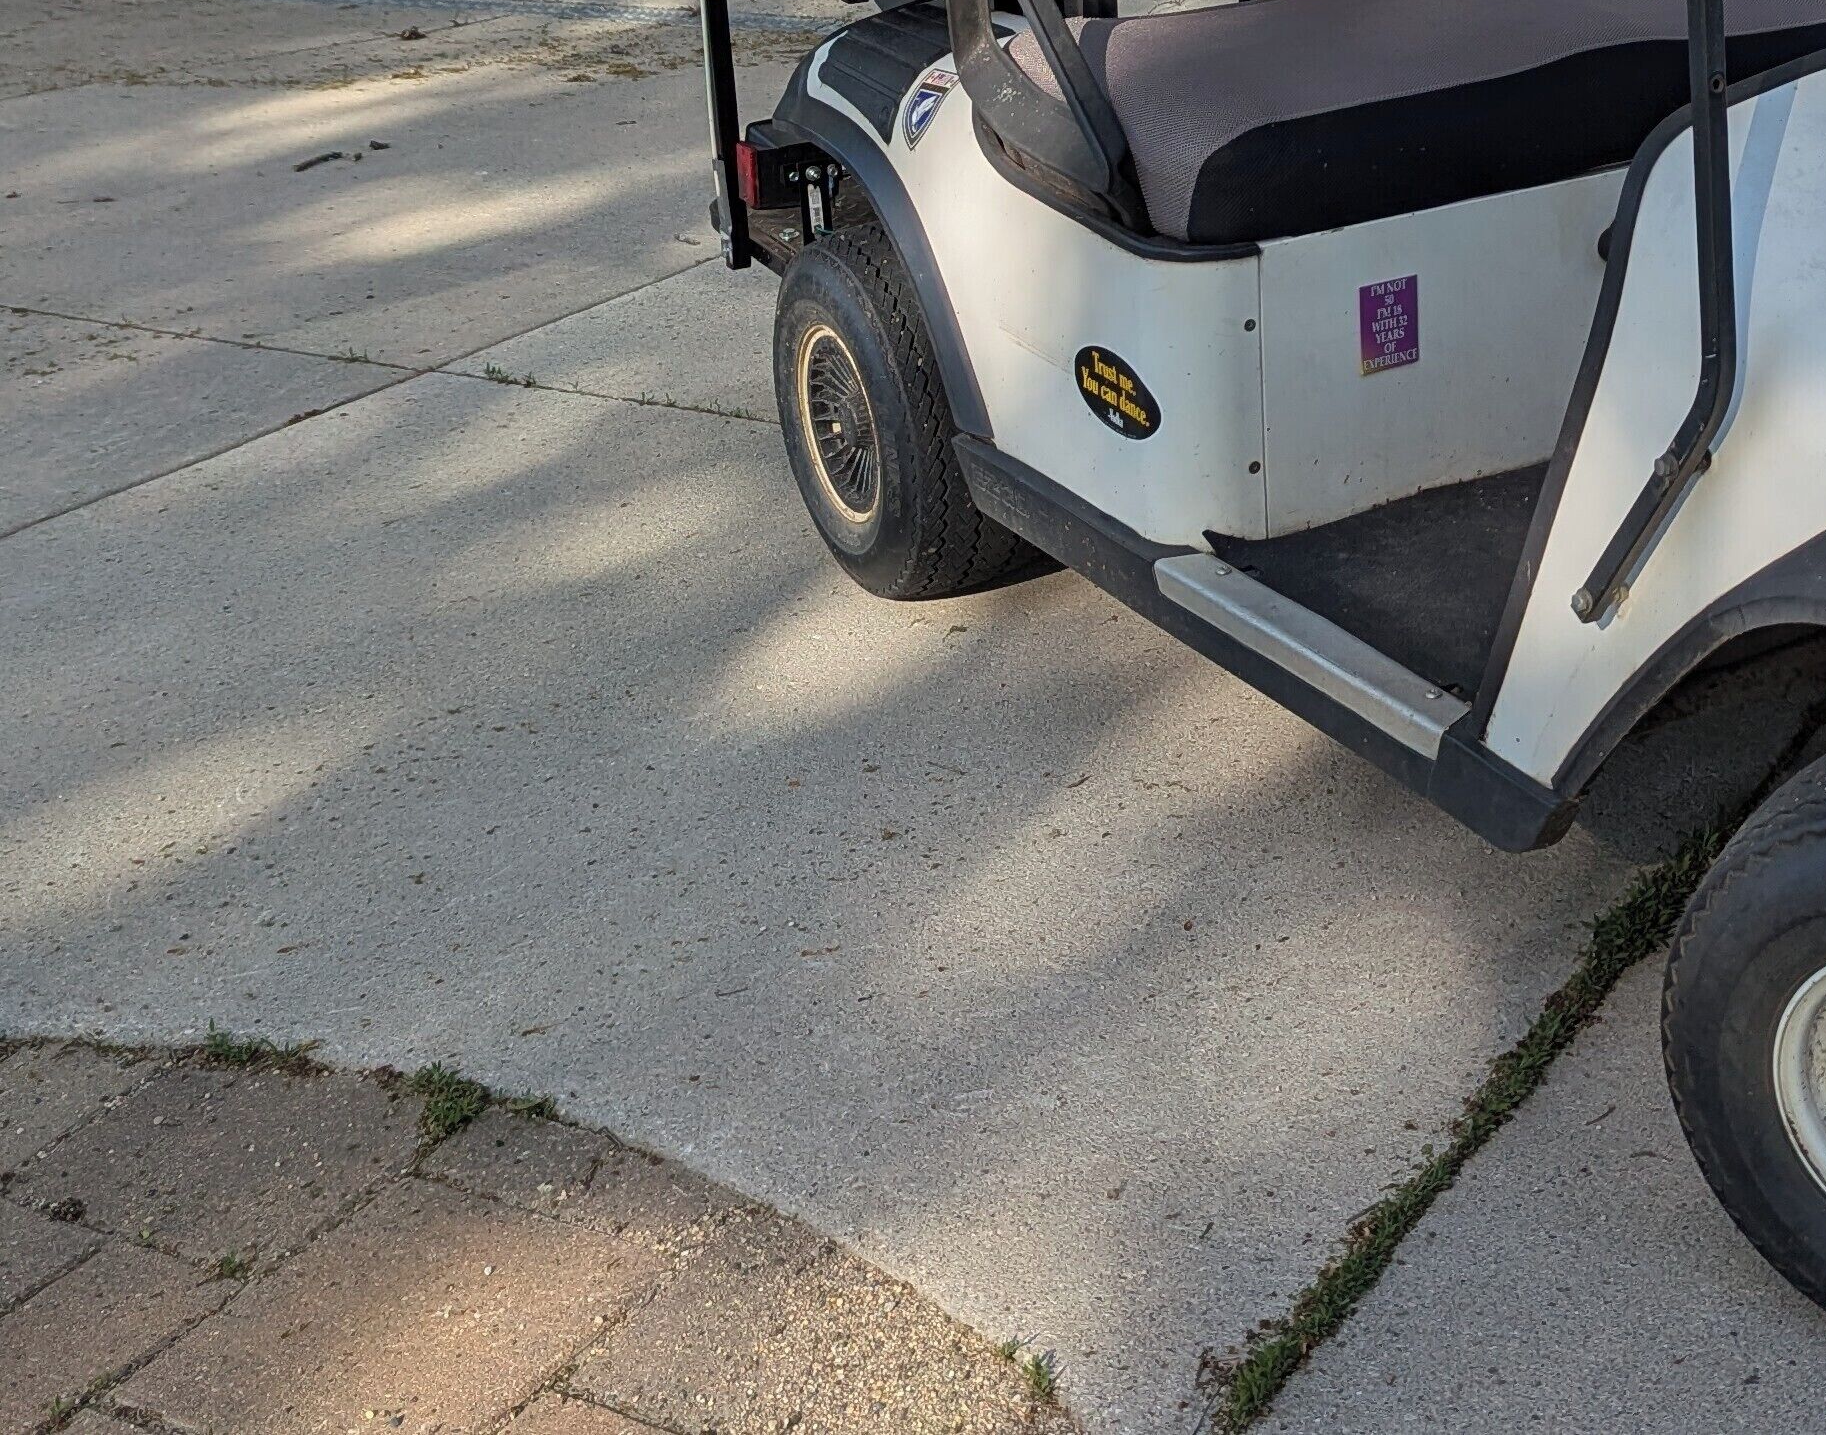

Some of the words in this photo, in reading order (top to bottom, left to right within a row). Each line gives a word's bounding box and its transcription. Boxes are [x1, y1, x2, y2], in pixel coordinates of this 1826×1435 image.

[1370, 284, 1385, 297] I'M
[1386, 278, 1407, 293] NOT
[1371, 317, 1398, 333] WITH
[1398, 314, 1409, 326] 32
[1375, 327, 1405, 343] YEARS
[1383, 341, 1397, 354] OF
[1363, 347, 1417, 370] EXPERIENCE
[1091, 350, 1118, 385] Trust
[1118, 373, 1137, 397] me.
[1081, 365, 1099, 396] You
[1100, 385, 1118, 407] can
[1119, 389, 1151, 427] dance.
